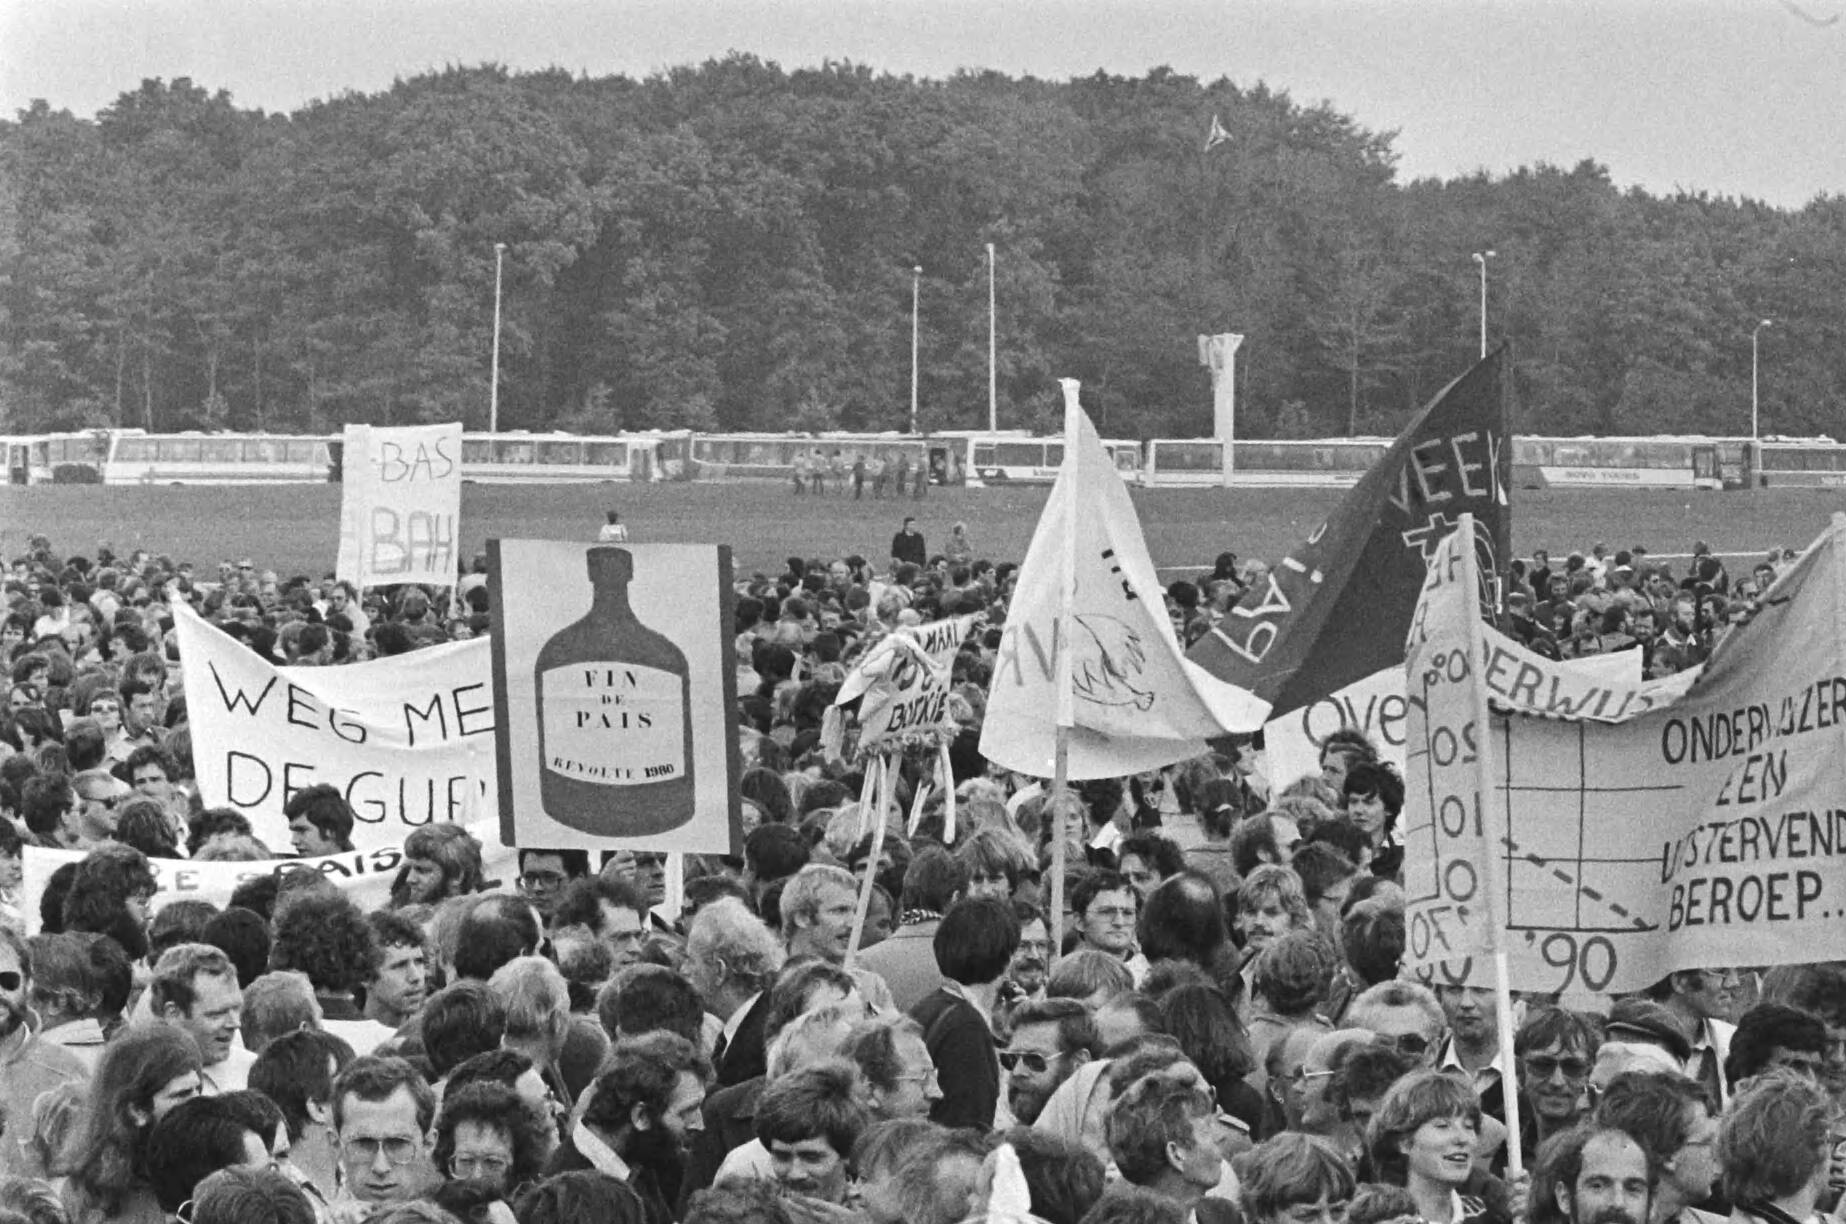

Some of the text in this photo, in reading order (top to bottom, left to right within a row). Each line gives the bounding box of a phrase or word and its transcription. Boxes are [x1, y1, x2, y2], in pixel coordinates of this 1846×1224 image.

[381, 436, 453, 482] BAS
[372, 506, 453, 574] BAH
[209, 661, 367, 744] WEG
[577, 711, 652, 729] PAIS
[228, 751, 315, 815] DE
[644, 763, 675, 778] 1980
